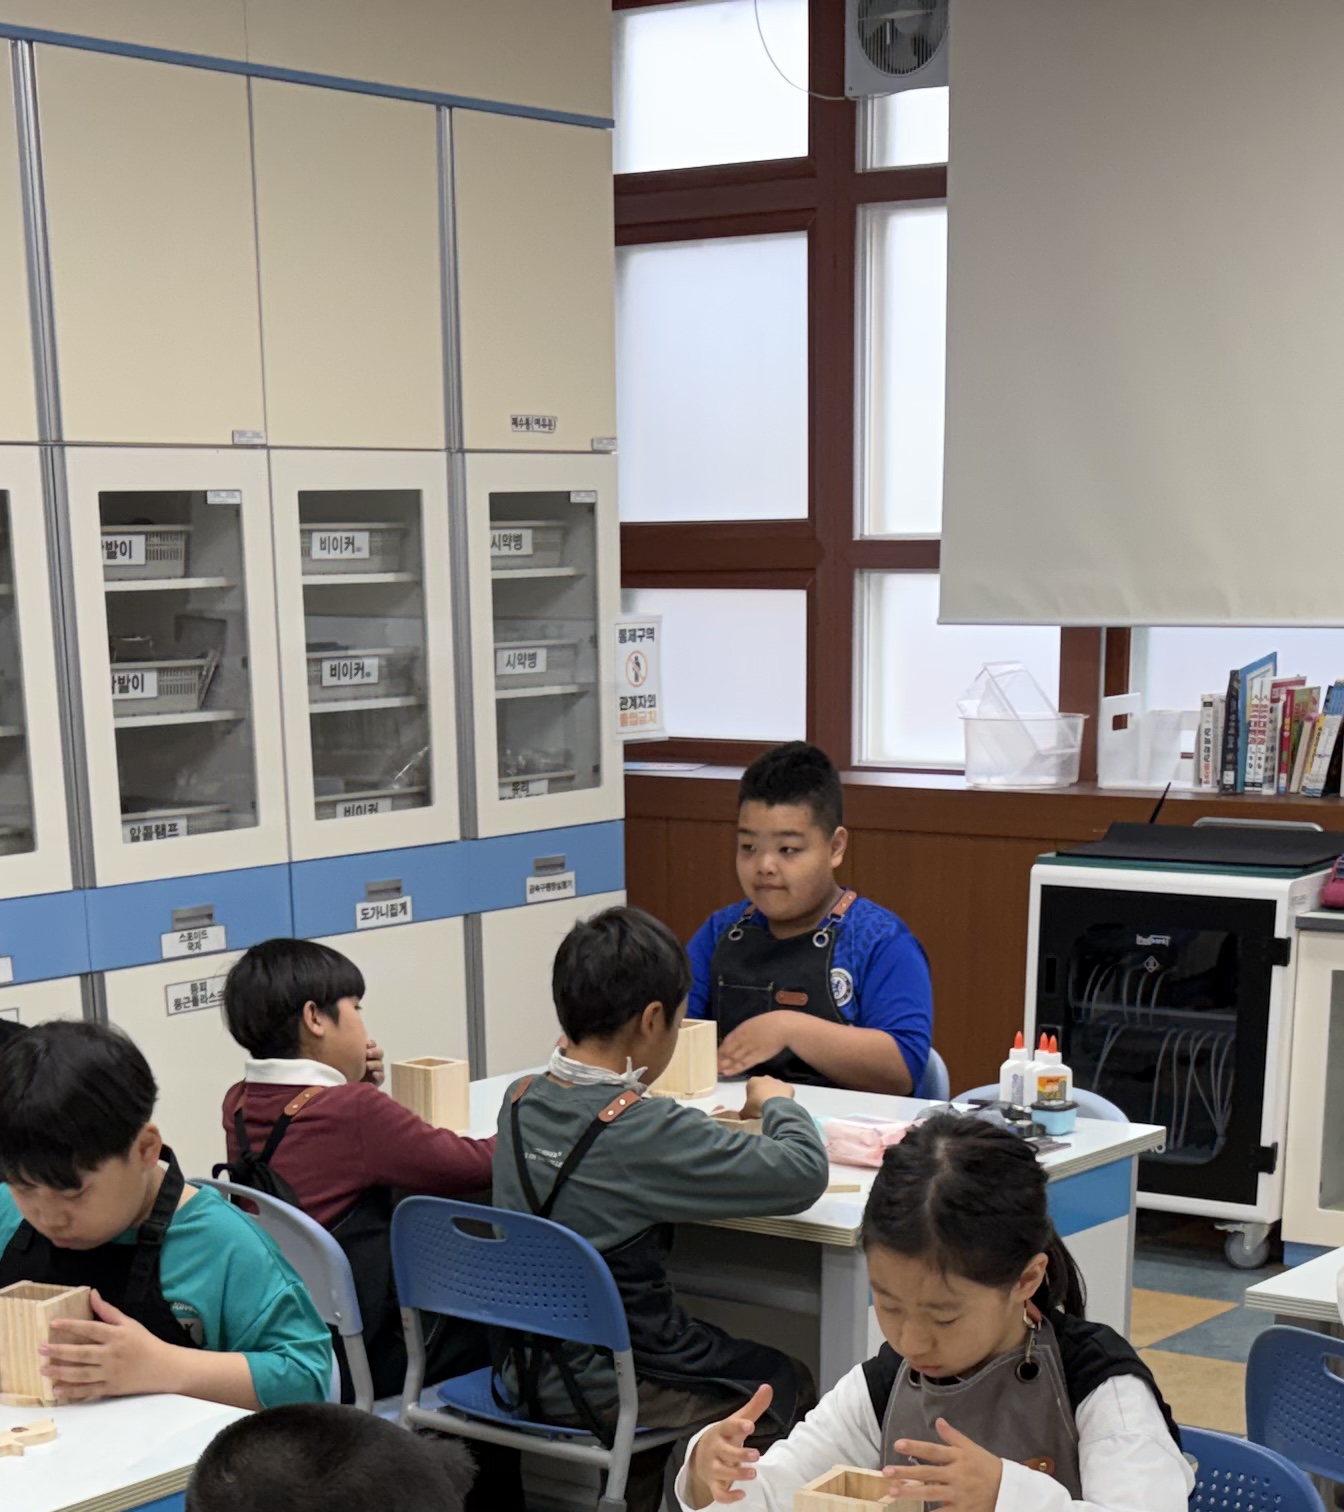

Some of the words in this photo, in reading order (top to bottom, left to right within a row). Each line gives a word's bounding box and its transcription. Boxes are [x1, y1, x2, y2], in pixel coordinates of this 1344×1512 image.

[102, 539, 133, 560] 발이
[490, 533, 523, 551] 시약병
[505, 651, 538, 670] 시약병
